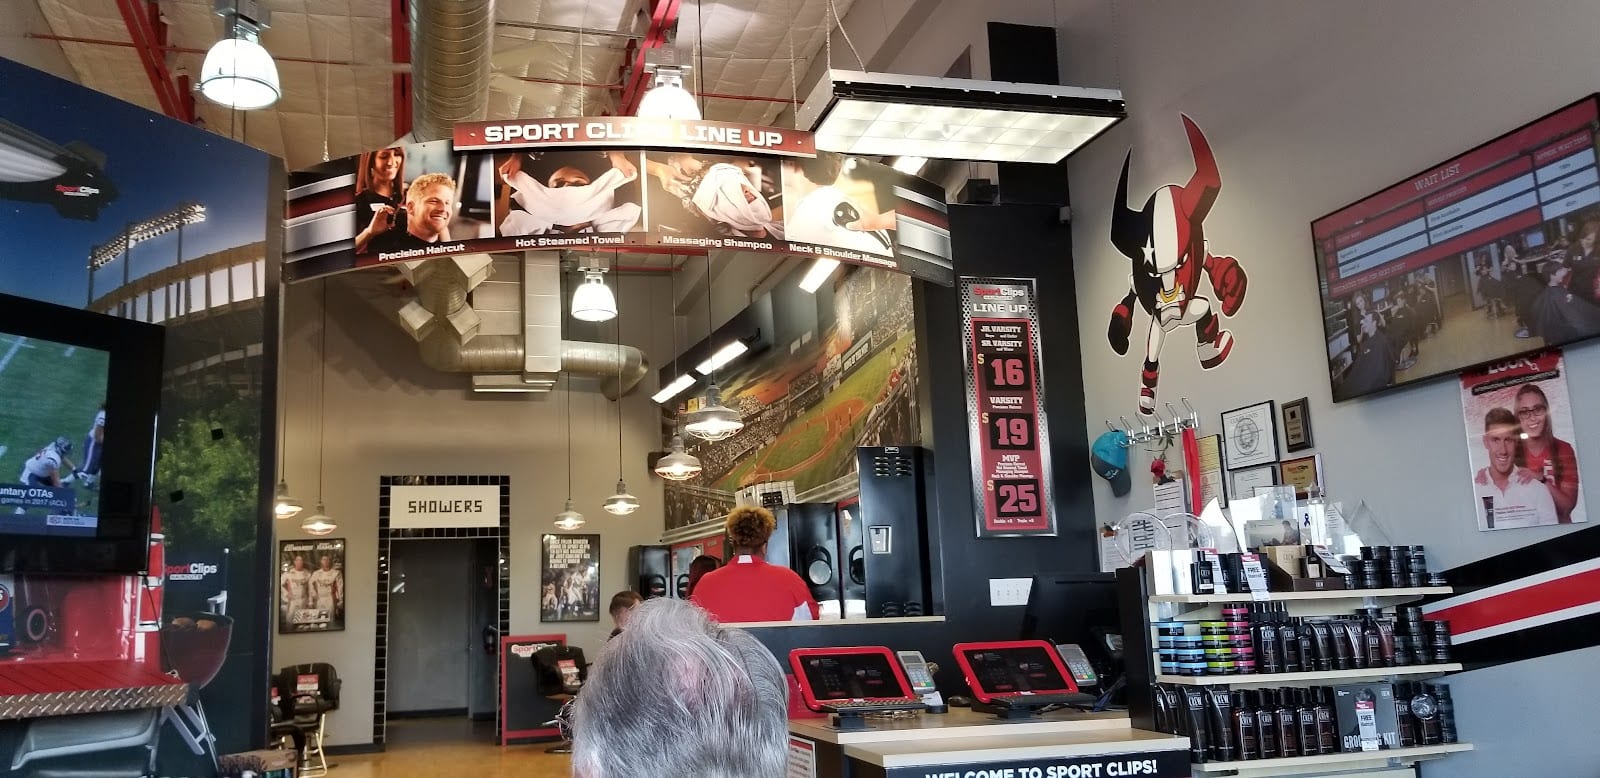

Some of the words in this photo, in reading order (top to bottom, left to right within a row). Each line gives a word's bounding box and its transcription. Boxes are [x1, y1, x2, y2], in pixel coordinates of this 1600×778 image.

[485, 122, 579, 144] SPORT
[586, 122, 673, 141] CLI
[681, 123, 744, 143] LINE
[748, 129, 783, 147] UP
[1414, 173, 1438, 191] WAIT
[1440, 163, 1461, 181] LIST
[516, 238, 537, 248] Hot
[539, 236, 590, 247] Steamed
[592, 235, 624, 246] Towel
[663, 235, 722, 249] Massaging
[724, 238, 774, 251] Shampoo
[379, 248, 425, 262] Precision
[427, 244, 466, 256] Haircut
[790, 243, 814, 254] Neck
[824, 247, 861, 260] Shoulder
[973, 303, 1005, 313] LINE
[1008, 304, 1027, 313] UP
[977, 354, 985, 365] $
[991, 358, 1025, 386] 16
[990, 396, 1023, 404] VARSITY
[982, 412, 989, 424] $
[995, 418, 1029, 446] 19
[29, 489, 54, 498] OTAs
[987, 480, 994, 491] $
[999, 485, 1038, 513] 25
[408, 500, 483, 514] SHOWERS
[164, 563, 218, 577] portClips
[1361, 714, 1373, 722] FREE
[1383, 732, 1396, 747] KIT
[1017, 767, 1043, 778] TO
[1046, 763, 1102, 778] SPORT
[1106, 759, 1158, 777] CLIPS!
